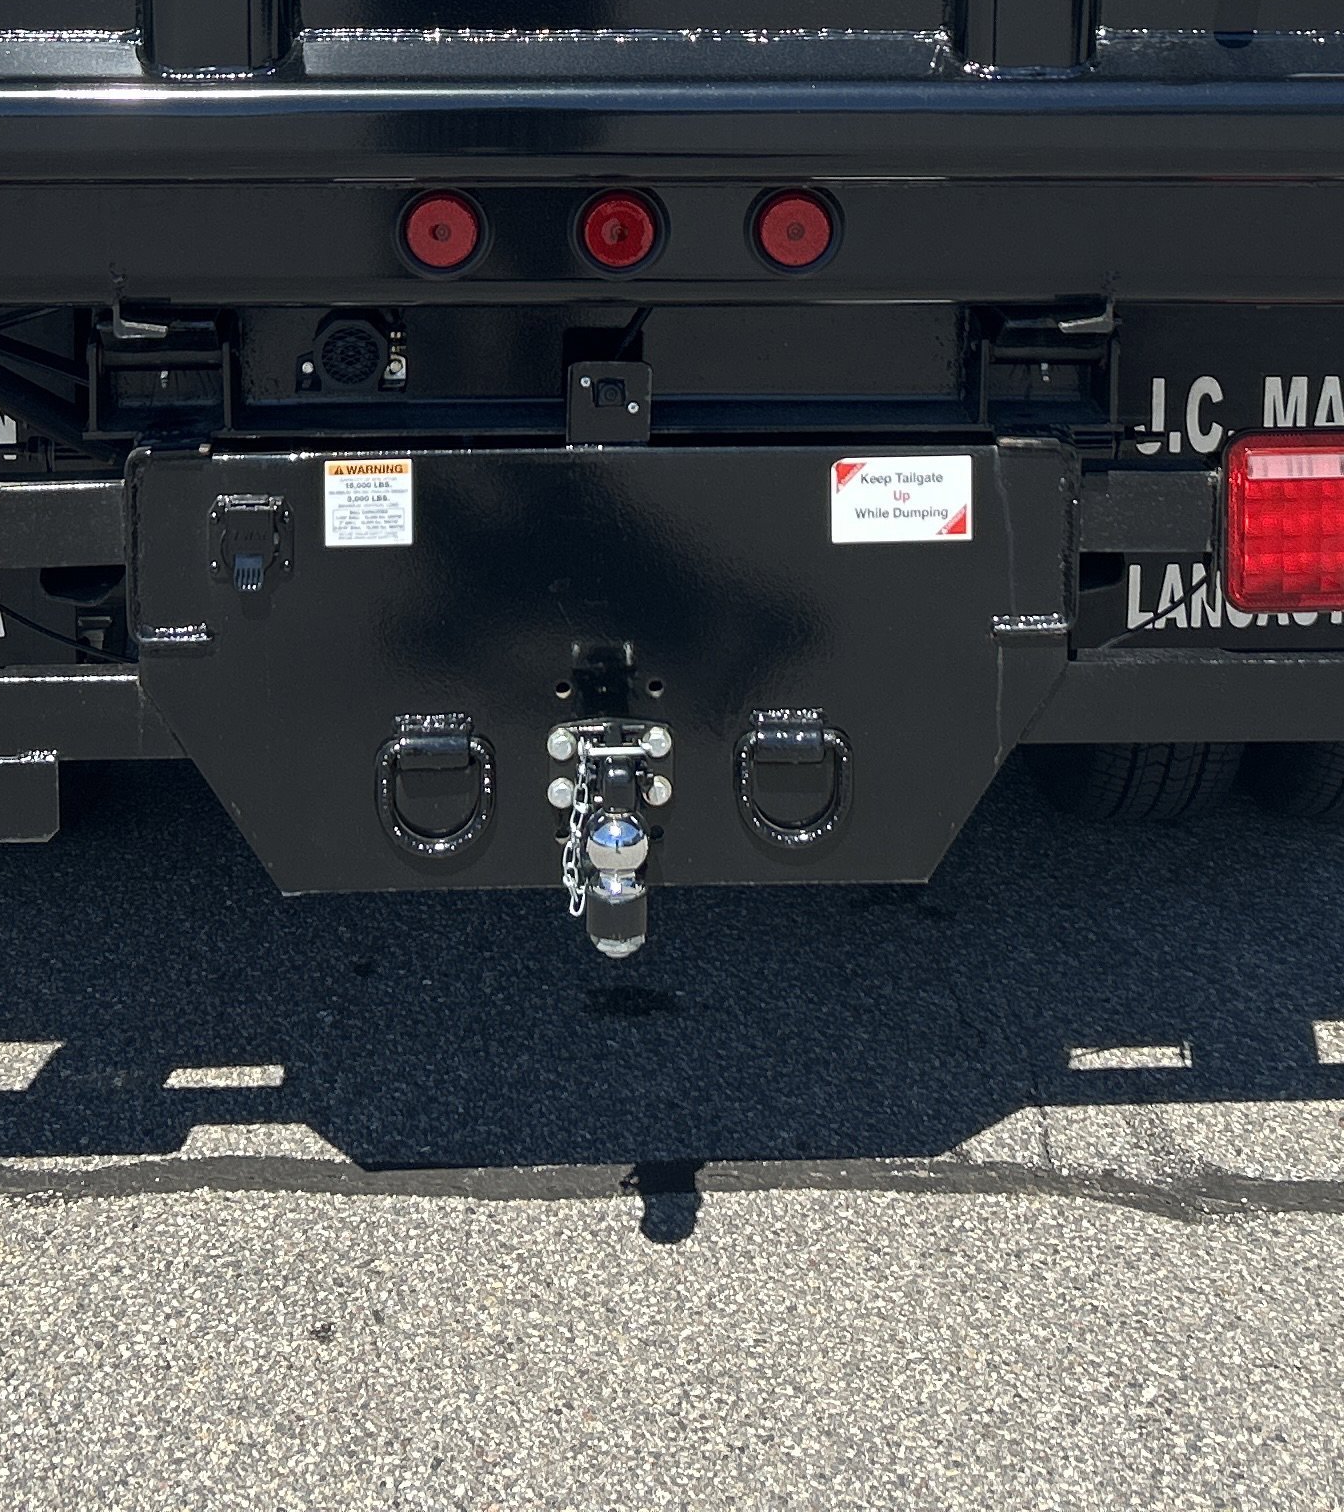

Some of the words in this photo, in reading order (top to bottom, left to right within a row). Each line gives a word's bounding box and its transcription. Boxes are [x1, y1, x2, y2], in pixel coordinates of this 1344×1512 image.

[346, 463, 404, 475] WARNING
[860, 473, 892, 486] Keep
[895, 472, 944, 486] Tailgate
[893, 490, 911, 503] Up
[855, 507, 890, 519] While
[893, 506, 949, 520] Dumping
